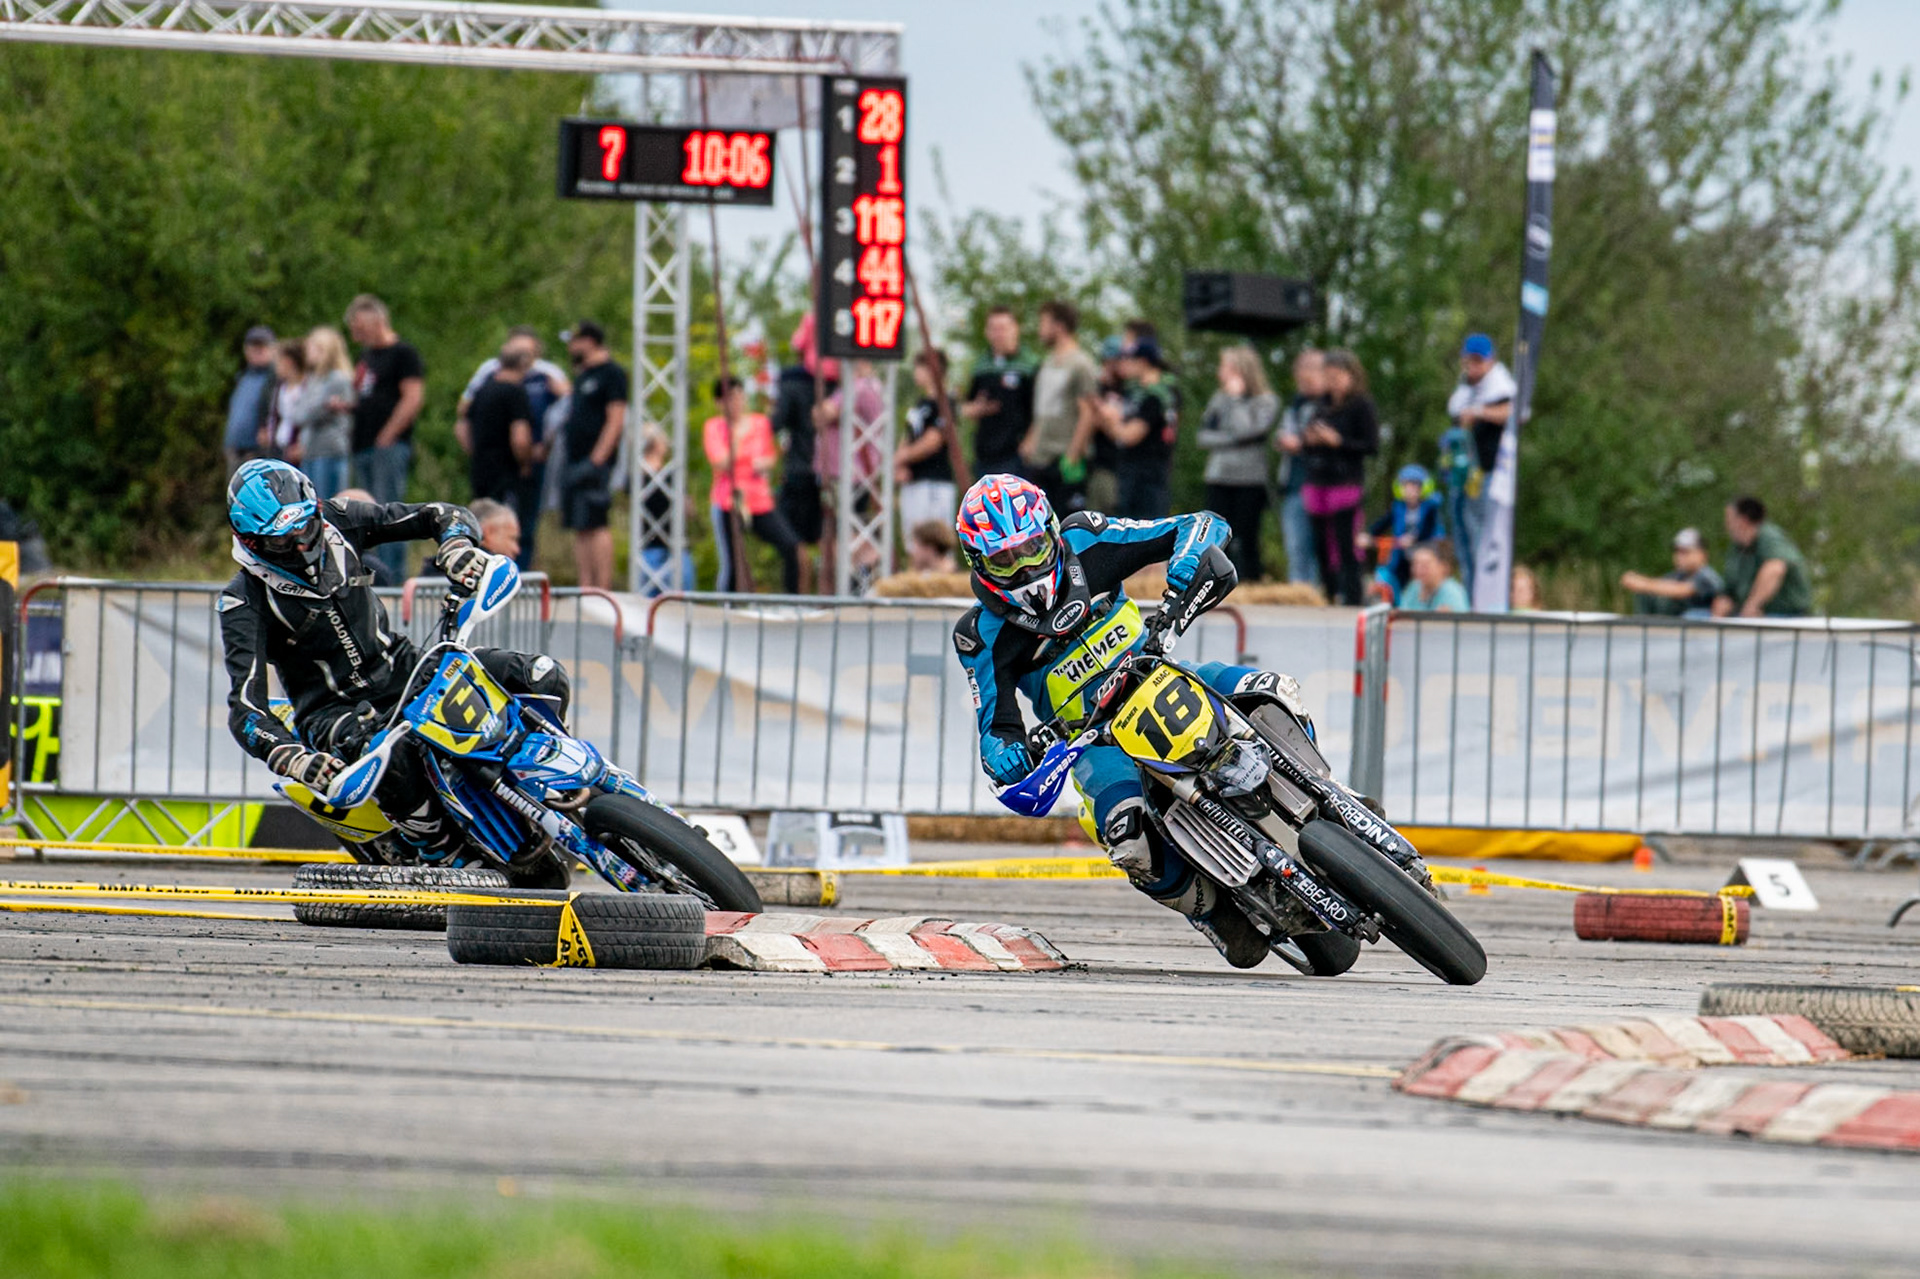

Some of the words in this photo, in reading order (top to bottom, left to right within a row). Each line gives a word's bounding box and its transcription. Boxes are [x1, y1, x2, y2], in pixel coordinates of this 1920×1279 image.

[836, 105, 854, 133] 1
[858, 88, 905, 144] 28
[599, 124, 627, 181] 7
[682, 130, 772, 188] 10:06
[835, 156, 856, 184] 2
[876, 143, 903, 195] 1
[835, 207, 854, 234] 3
[852, 193, 906, 245] 116
[834, 258, 854, 285] 4
[857, 244, 905, 298] 44
[835, 308, 854, 336] 5
[852, 296, 905, 348] 117
[1180, 580, 1214, 630] ACERBIS
[443, 659, 463, 680] ADAC
[1066, 624, 1129, 682] HIEMER
[1153, 670, 1171, 687] ADAC
[442, 665, 492, 735] 6
[1135, 675, 1204, 760] 18
[1039, 751, 1078, 796] ACERBIS
[496, 783, 544, 822] WINKL
[719, 828, 737, 850] 3
[1769, 872, 1791, 898] 5
